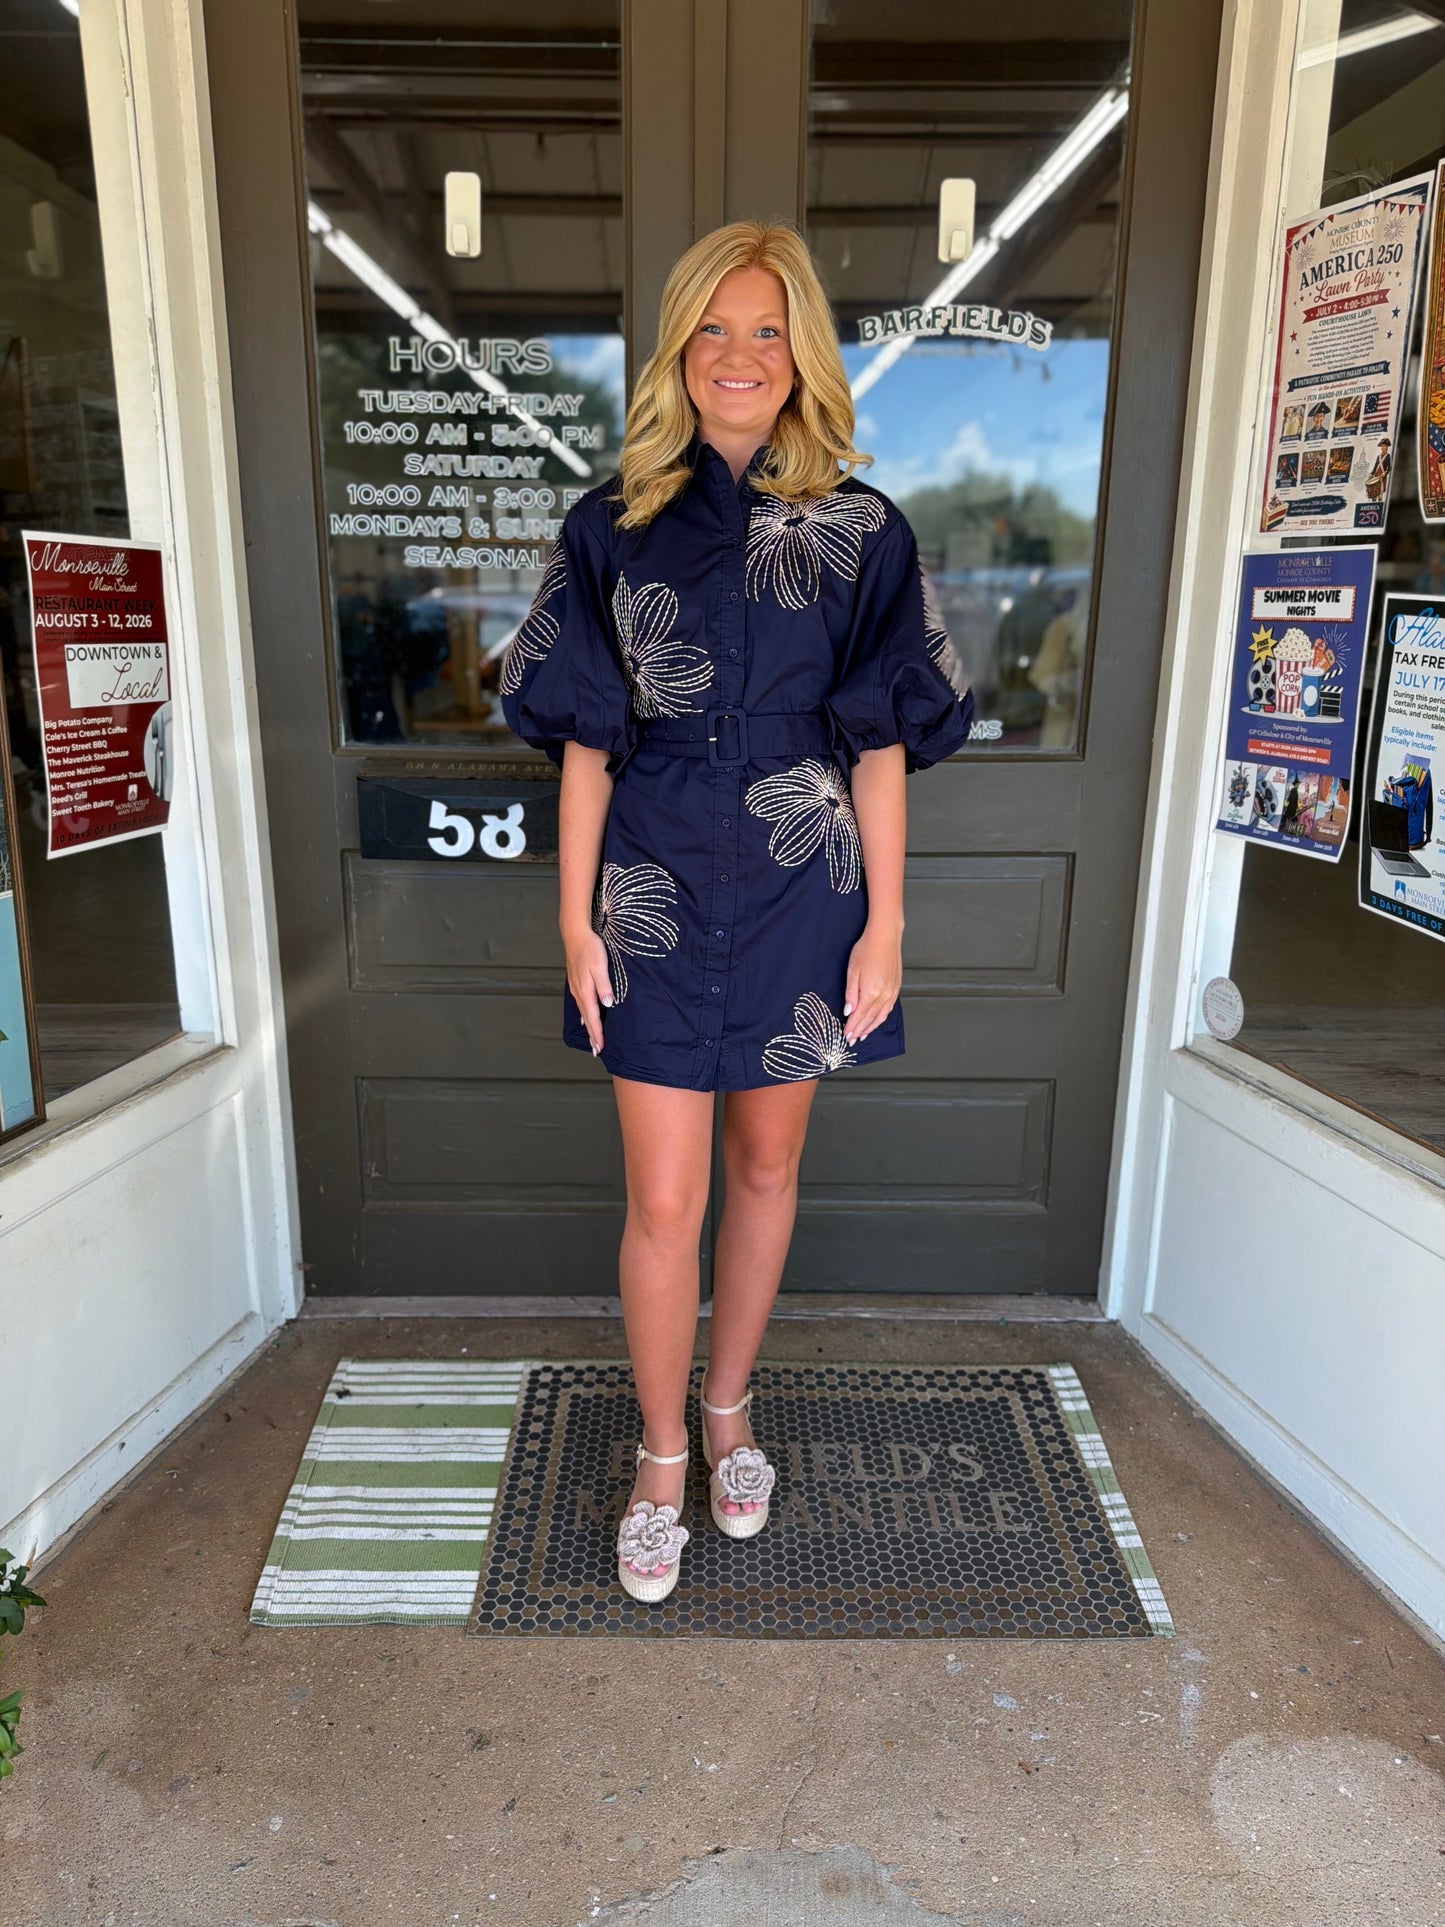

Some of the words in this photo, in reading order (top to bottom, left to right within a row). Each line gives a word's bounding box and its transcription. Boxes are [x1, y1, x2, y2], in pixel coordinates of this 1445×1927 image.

[1351, 216, 1379, 230] COUNTY
[1330, 227, 1374, 250] MUSEUM
[1300, 245, 1375, 291] AMERICA
[1375, 243, 1403, 265] 250
[1314, 280, 1351, 303] Lawn
[1353, 268, 1385, 291] Party
[1315, 305, 1333, 318] JULY
[1333, 303, 1338, 313] 2
[1319, 312, 1357, 327] COURTHOUSE
[1358, 308, 1372, 319] LAWN
[858, 304, 1054, 351] BARFIELD'S
[389, 336, 554, 374] HOURS
[358, 390, 584, 416] TUESDAY-FRIDAY
[344, 422, 419, 444] 10:00
[425, 423, 467, 445] AM
[491, 424, 554, 447] 5:00
[561, 426, 604, 449] PM
[404, 453, 545, 478] SATURDAY
[346, 484, 421, 506] 10:00
[428, 486, 469, 507] AM
[493, 488, 556, 509] 3:00
[1359, 511, 1379, 524] 250
[329, 514, 461, 537] MONDAYS
[467, 517, 489, 537] &
[31, 543, 129, 576] Monroeville
[404, 546, 546, 569] SEASONAL
[1278, 557, 1333, 568] MONROEVILLE
[1277, 568, 1303, 577] MONROE
[1304, 567, 1332, 576] COUNTY
[89, 577, 114, 591] Main
[114, 578, 137, 592] Street
[35, 596, 120, 611] RESTAURANT
[124, 599, 156, 611] WEEK
[1263, 590, 1306, 603] SUMMER
[1308, 590, 1341, 603] MOVIE
[1287, 606, 1316, 616] NIGHTS
[36, 614, 88, 628] AUGUST
[91, 614, 98, 628] 3
[108, 614, 123, 629] 12,
[125, 614, 152, 628] 2026
[1256, 638, 1269, 648] FREE
[66, 646, 151, 661] DOWNTOWN
[154, 646, 162, 659] &
[1394, 652, 1417, 666] TAX
[101, 662, 163, 702] Local
[1283, 674, 1300, 683] POP
[1395, 671, 1430, 689] JULY
[1281, 684, 1300, 693] CORN
[1393, 690, 1415, 702] During
[1416, 694, 1428, 702] this
[1388, 706, 1408, 716] books,
[1409, 710, 1421, 718] and
[1394, 700, 1416, 708] certain
[1417, 703, 1439, 712] school
[45, 720, 56, 730] Big
[58, 718, 81, 728] Potato
[82, 716, 113, 726] Company
[1273, 723, 1299, 733] Sponsored
[45, 732, 66, 742] Cole's
[67, 730, 78, 739] Ice
[79, 728, 100, 738] Cream
[107, 726, 128, 735] Coffee
[1248, 728, 1257, 736] GP
[1257, 730, 1279, 738] Cellulose
[1284, 733, 1295, 742] City
[1302, 734, 1332, 745] Monroeville
[1391, 726, 1415, 736] Eligible
[1415, 731, 1434, 741] items
[46, 745, 70, 755] Cherry
[71, 742, 92, 751] Street
[93, 740, 108, 749] BBQ
[1384, 735, 1410, 747] typically
[1411, 740, 1438, 751] include:
[48, 758, 61, 767] The
[63, 754, 93, 765] Maverick
[94, 750, 129, 761] Steakhouse
[49, 770, 75, 780] Monroe
[77, 765, 105, 775] Nutrition
[51, 782, 65, 792] Mrs.
[66, 778, 92, 789] Teresa's
[93, 774, 128, 785] Homemade
[128, 770, 147, 779] Treats
[51, 795, 73, 805] Reed's
[74, 791, 88, 800] Grill
[115, 799, 149, 811] MONROEVILLE
[52, 807, 72, 817] Sweet
[73, 803, 92, 813] Tooth
[93, 799, 114, 810] Bakery
[118, 808, 130, 816] MAIN
[131, 805, 145, 814] STREET
[55, 834, 64, 844] 10
[68, 828, 91, 841] DAYS
[94, 825, 104, 835] OF
[427, 800, 526, 859] 58
[1411, 896, 1428, 909] MAIN
[1371, 895, 1377, 905] 3
[1379, 898, 1403, 915] DAYS
[1406, 909, 1427, 926] FREE
[1430, 920, 1443, 932] OF
